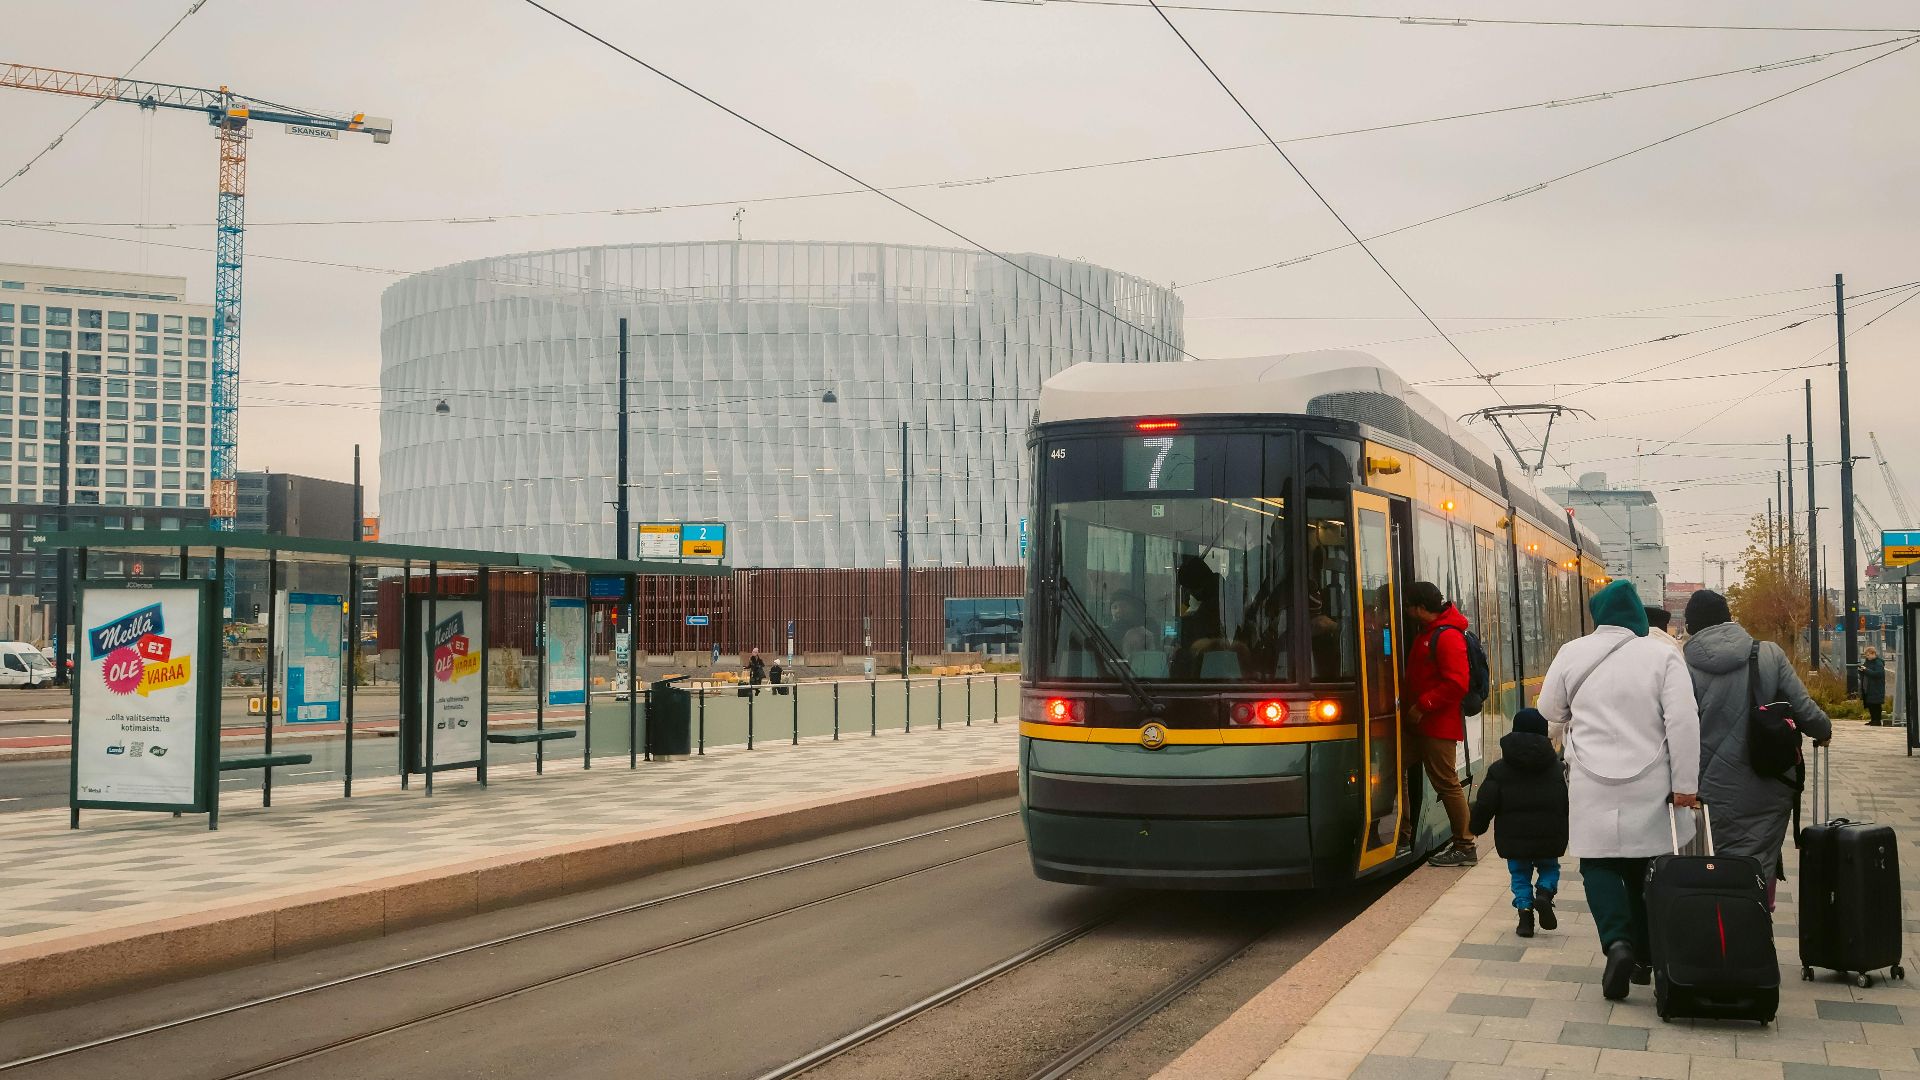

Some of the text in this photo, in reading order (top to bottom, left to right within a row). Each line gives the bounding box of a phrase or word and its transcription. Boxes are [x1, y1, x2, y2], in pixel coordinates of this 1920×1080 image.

[291, 126, 332, 138] SKANSKA
[1051, 449, 1066, 459] 445
[1143, 437, 1174, 488] 7
[700, 528, 707, 540] 2
[1904, 534, 1908, 544] 1
[99, 612, 154, 650] Meillä
[147, 641, 165, 655] EI
[109, 659, 139, 682] OLE
[435, 657, 452, 673] OLE
[147, 664, 184, 685] VARAA
[126, 715, 170, 723] valitsematta
